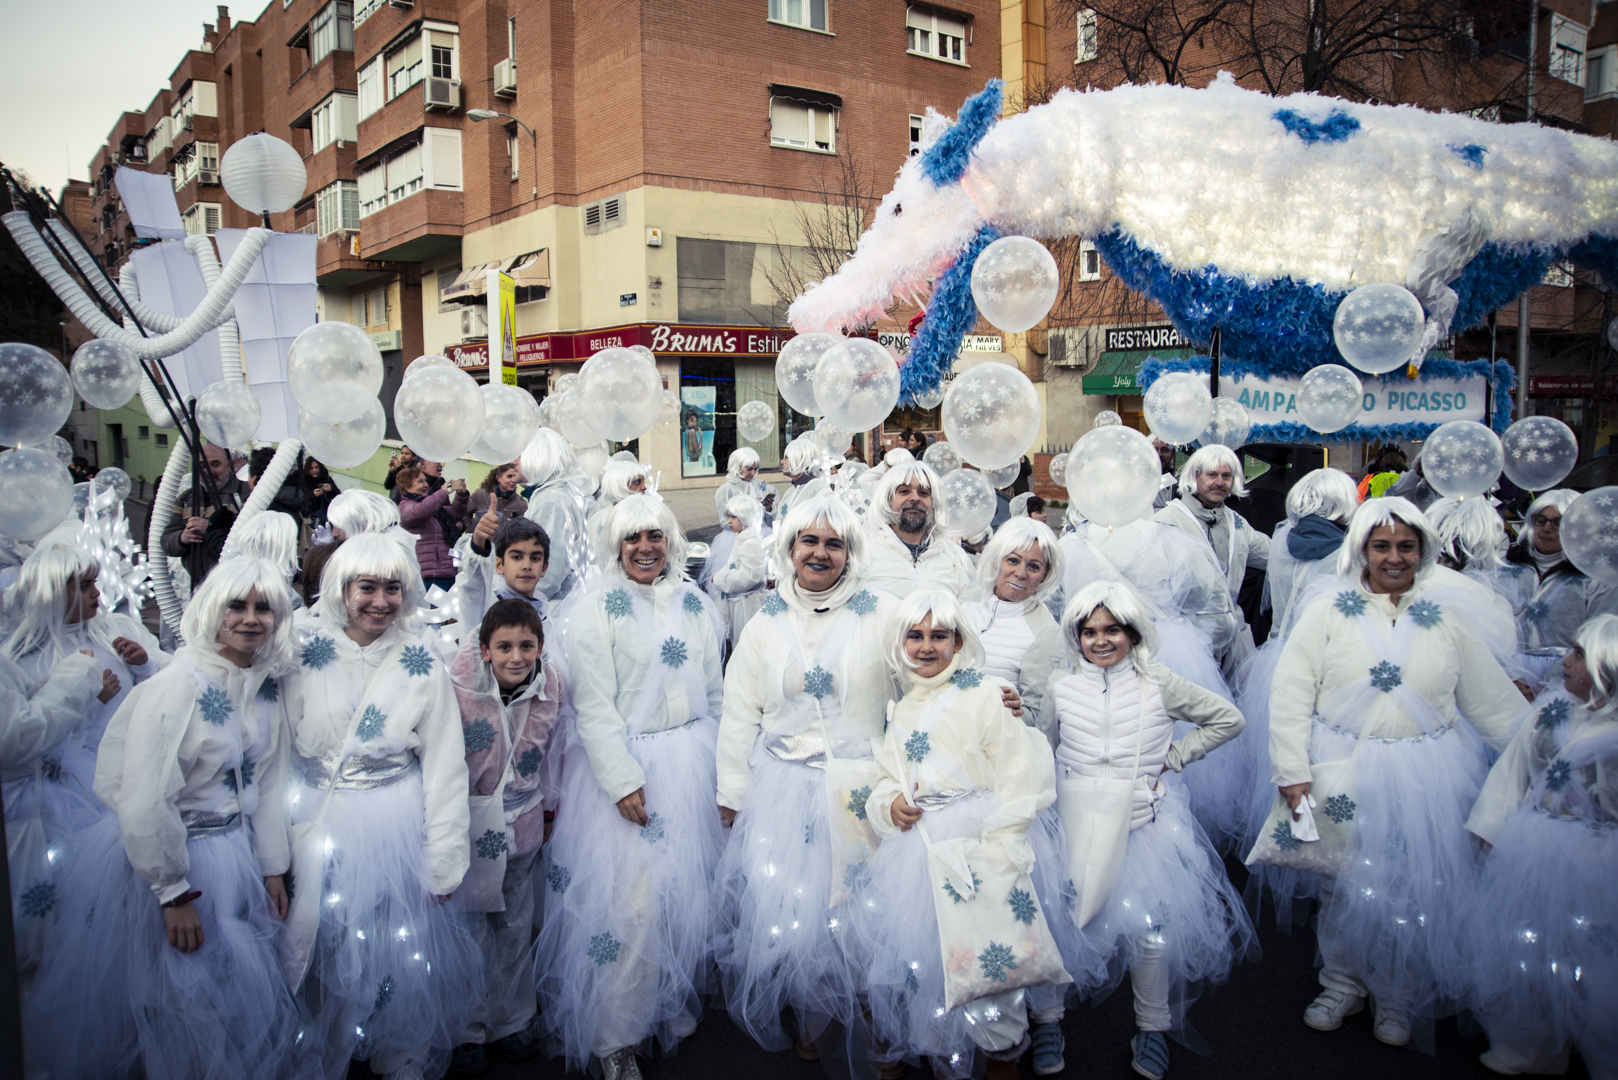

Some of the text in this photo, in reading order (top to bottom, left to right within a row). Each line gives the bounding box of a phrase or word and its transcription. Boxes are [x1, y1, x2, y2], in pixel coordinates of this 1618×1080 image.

[516, 344, 531, 352] OMBRE
[591, 336, 622, 350] BELLEZA
[1112, 375, 1132, 388] Yoly
[1238, 387, 1298, 414] AMPA
[1387, 391, 1467, 411] PICASSO
